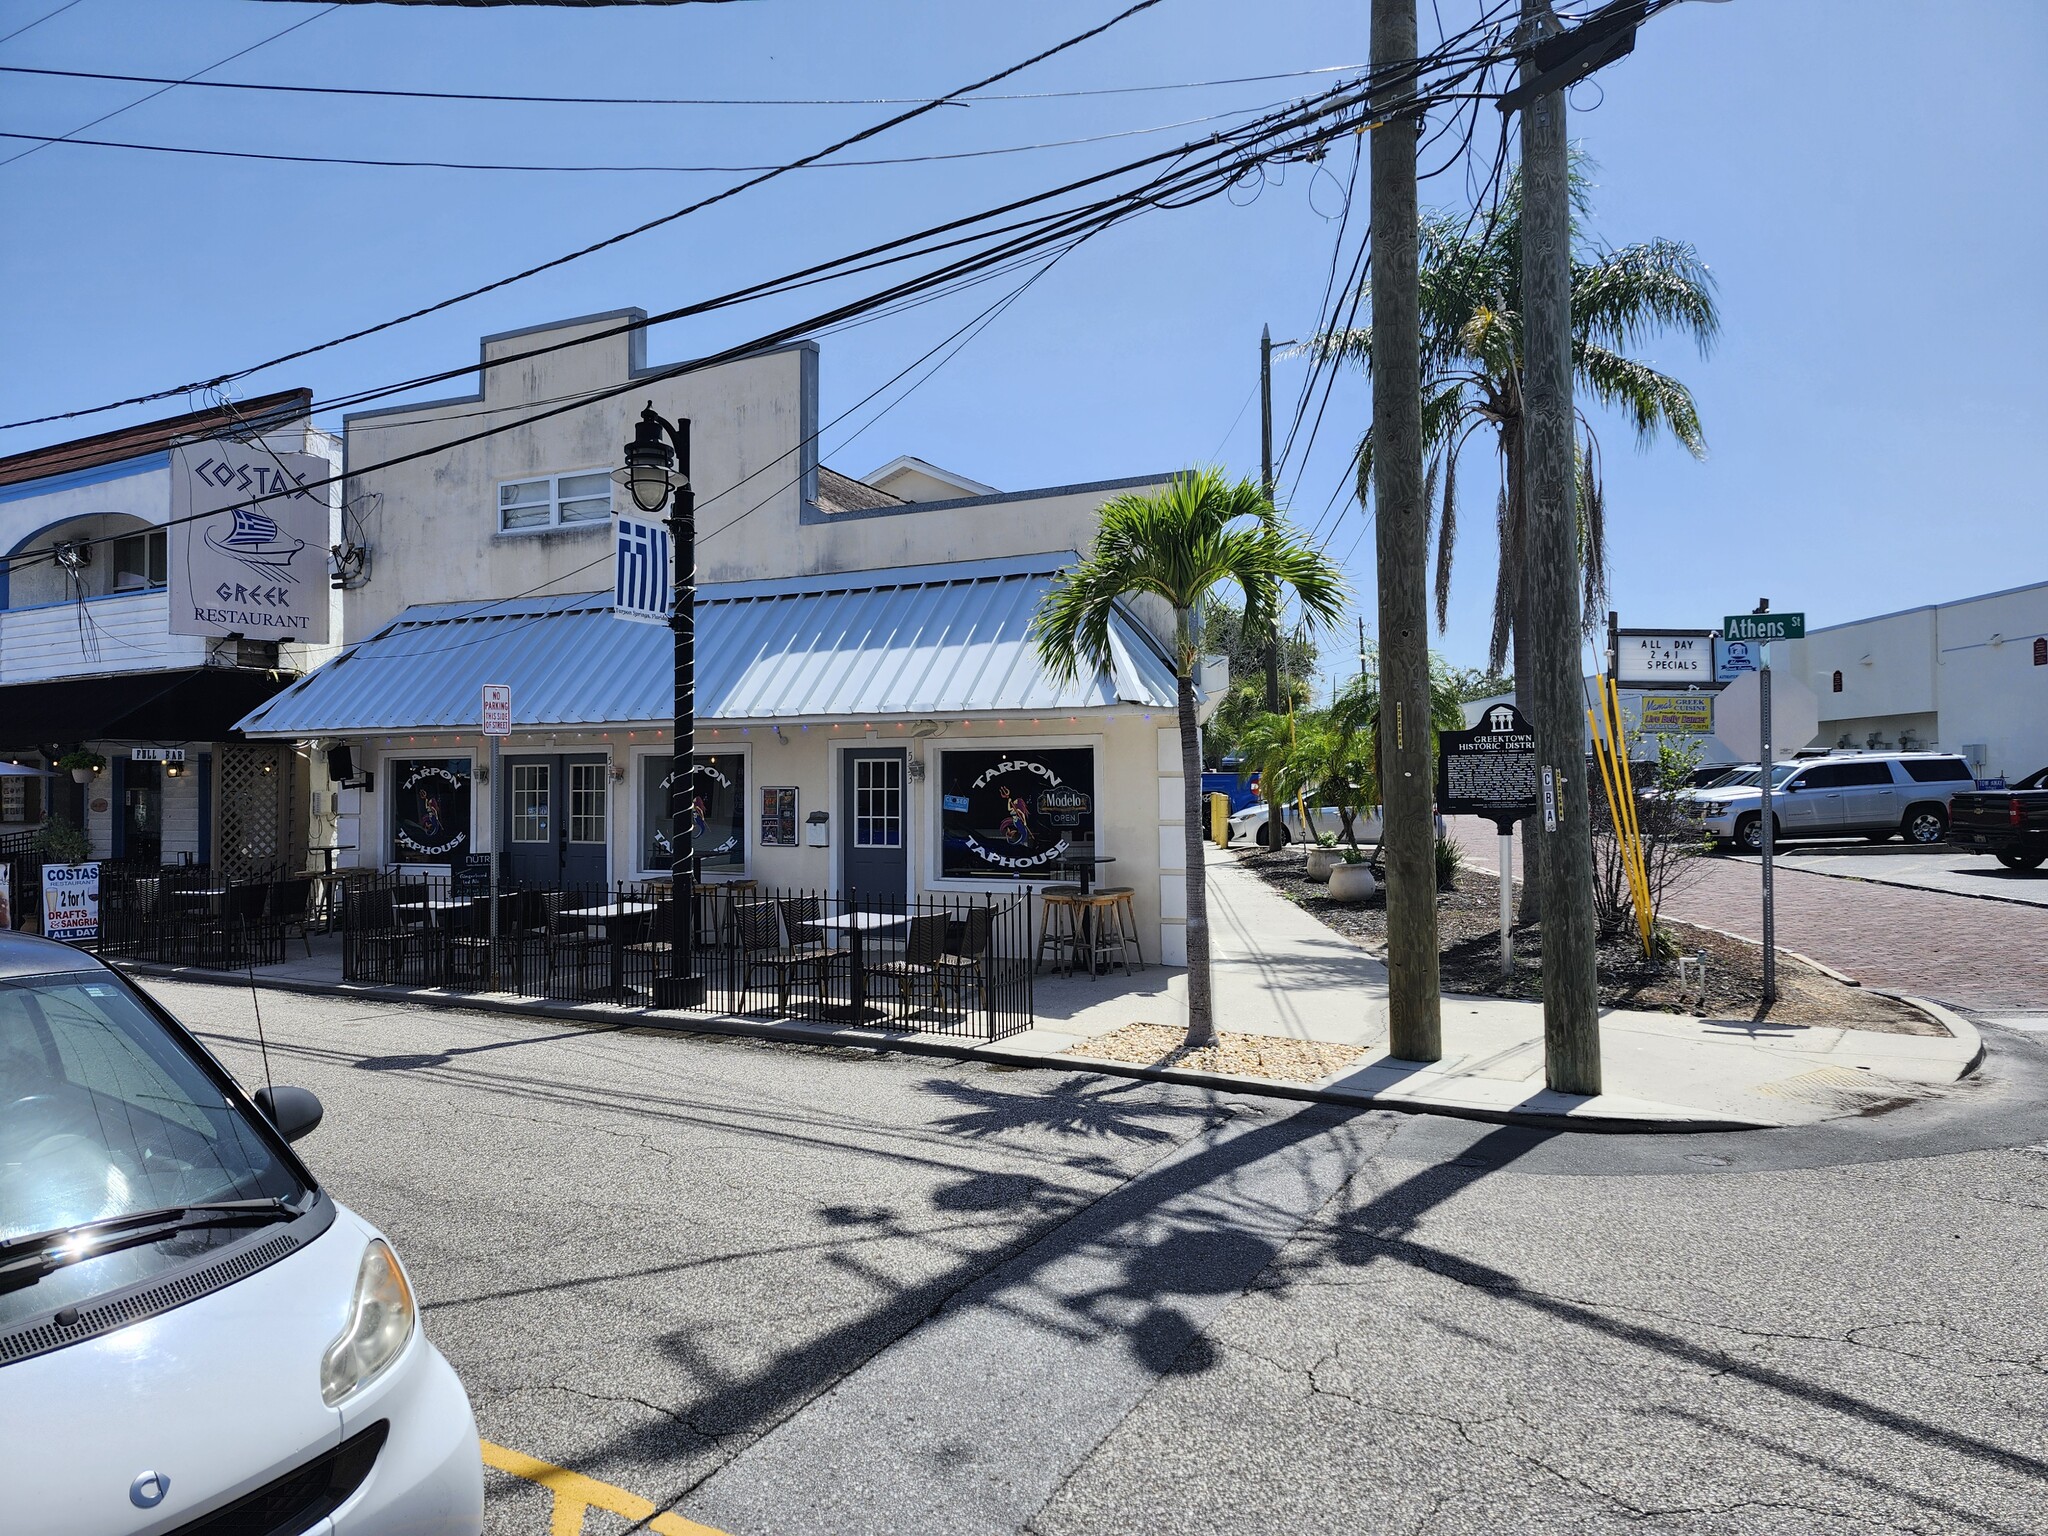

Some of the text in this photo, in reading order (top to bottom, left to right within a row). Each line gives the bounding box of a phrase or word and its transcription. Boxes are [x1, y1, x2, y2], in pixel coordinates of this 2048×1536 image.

[195, 458, 306, 500] COSTAS
[216, 582, 290, 608] GREEK
[194, 607, 310, 628] RESTAURANT
[1728, 616, 1801, 639] Athens St
[1641, 640, 1693, 649] ALL DAY
[1647, 661, 1698, 669] SPECIALS
[493, 692, 500, 700] NO
[485, 702, 508, 711] PARKING
[1473, 734, 1532, 743] GREEKTOWN
[1459, 741, 1535, 751] HISTORIC DISTRI
[165, 751, 182, 760] BAR
[403, 768, 461, 790] TARPON
[659, 765, 731, 789] TPON
[972, 761, 1062, 787] TARPON
[945, 797, 967, 805] CLSED
[1047, 794, 1081, 807] Modelo
[398, 828, 466, 855] TAPHOUSE
[964, 835, 1069, 868] TAPHOUSE
[47, 868, 98, 881] COSTAS
[61, 890, 86, 907] 2 for 1
[48, 910, 88, 920] DRAFTS
[50, 918, 98, 929] & SANGRIA
[53, 928, 97, 939] ALL DAY
